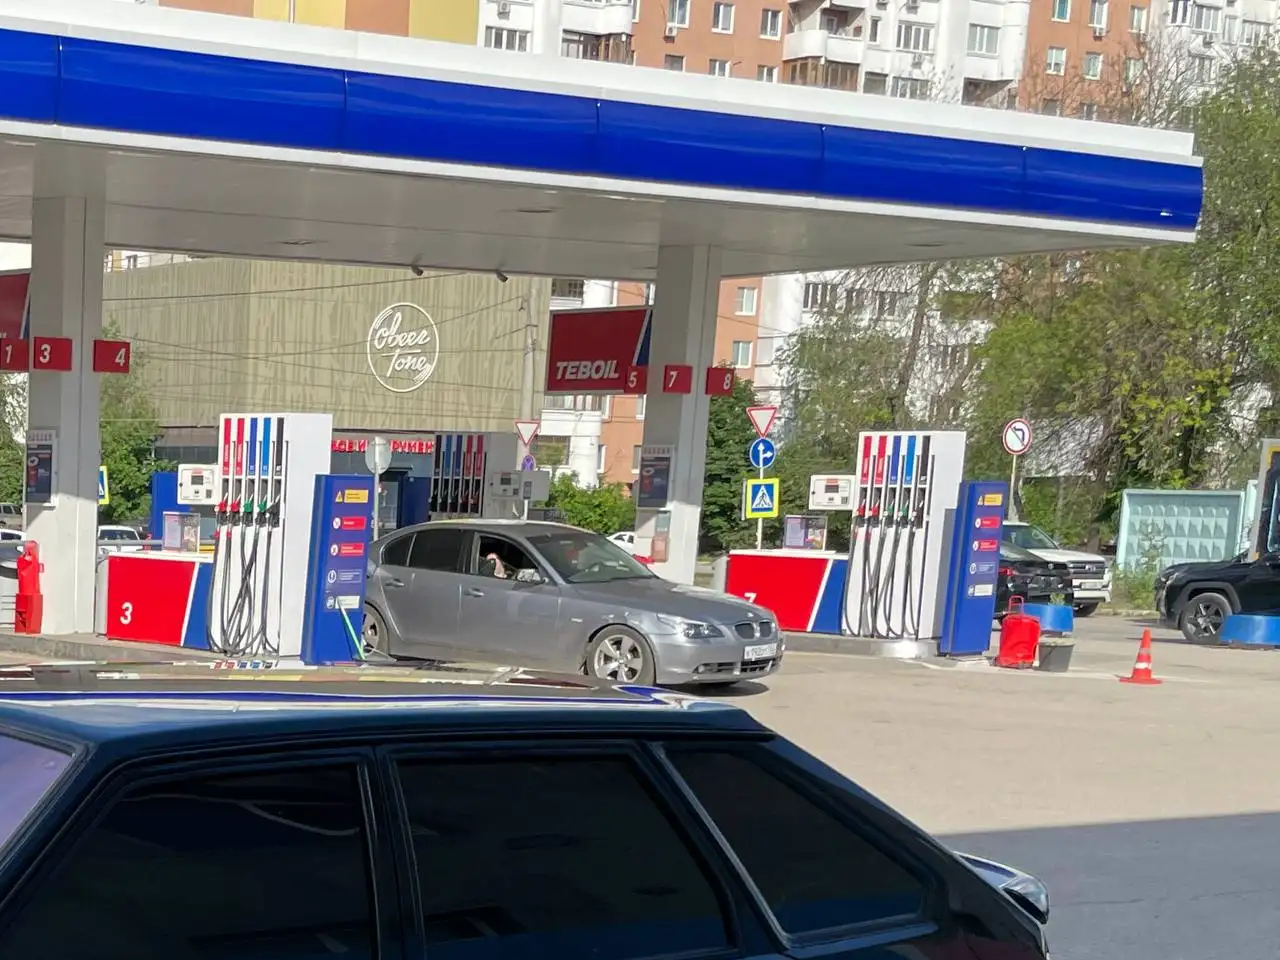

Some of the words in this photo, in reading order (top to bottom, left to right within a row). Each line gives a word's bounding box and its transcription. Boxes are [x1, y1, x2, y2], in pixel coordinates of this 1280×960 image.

[5, 344, 13, 364] 1
[40, 344, 51, 364] 3
[115, 347, 126, 367] 4
[556, 360, 619, 380] TEBOIL
[628, 371, 638, 388] 5
[669, 371, 677, 388] 7
[723, 373, 732, 390] 8
[120, 602, 133, 625] 3
